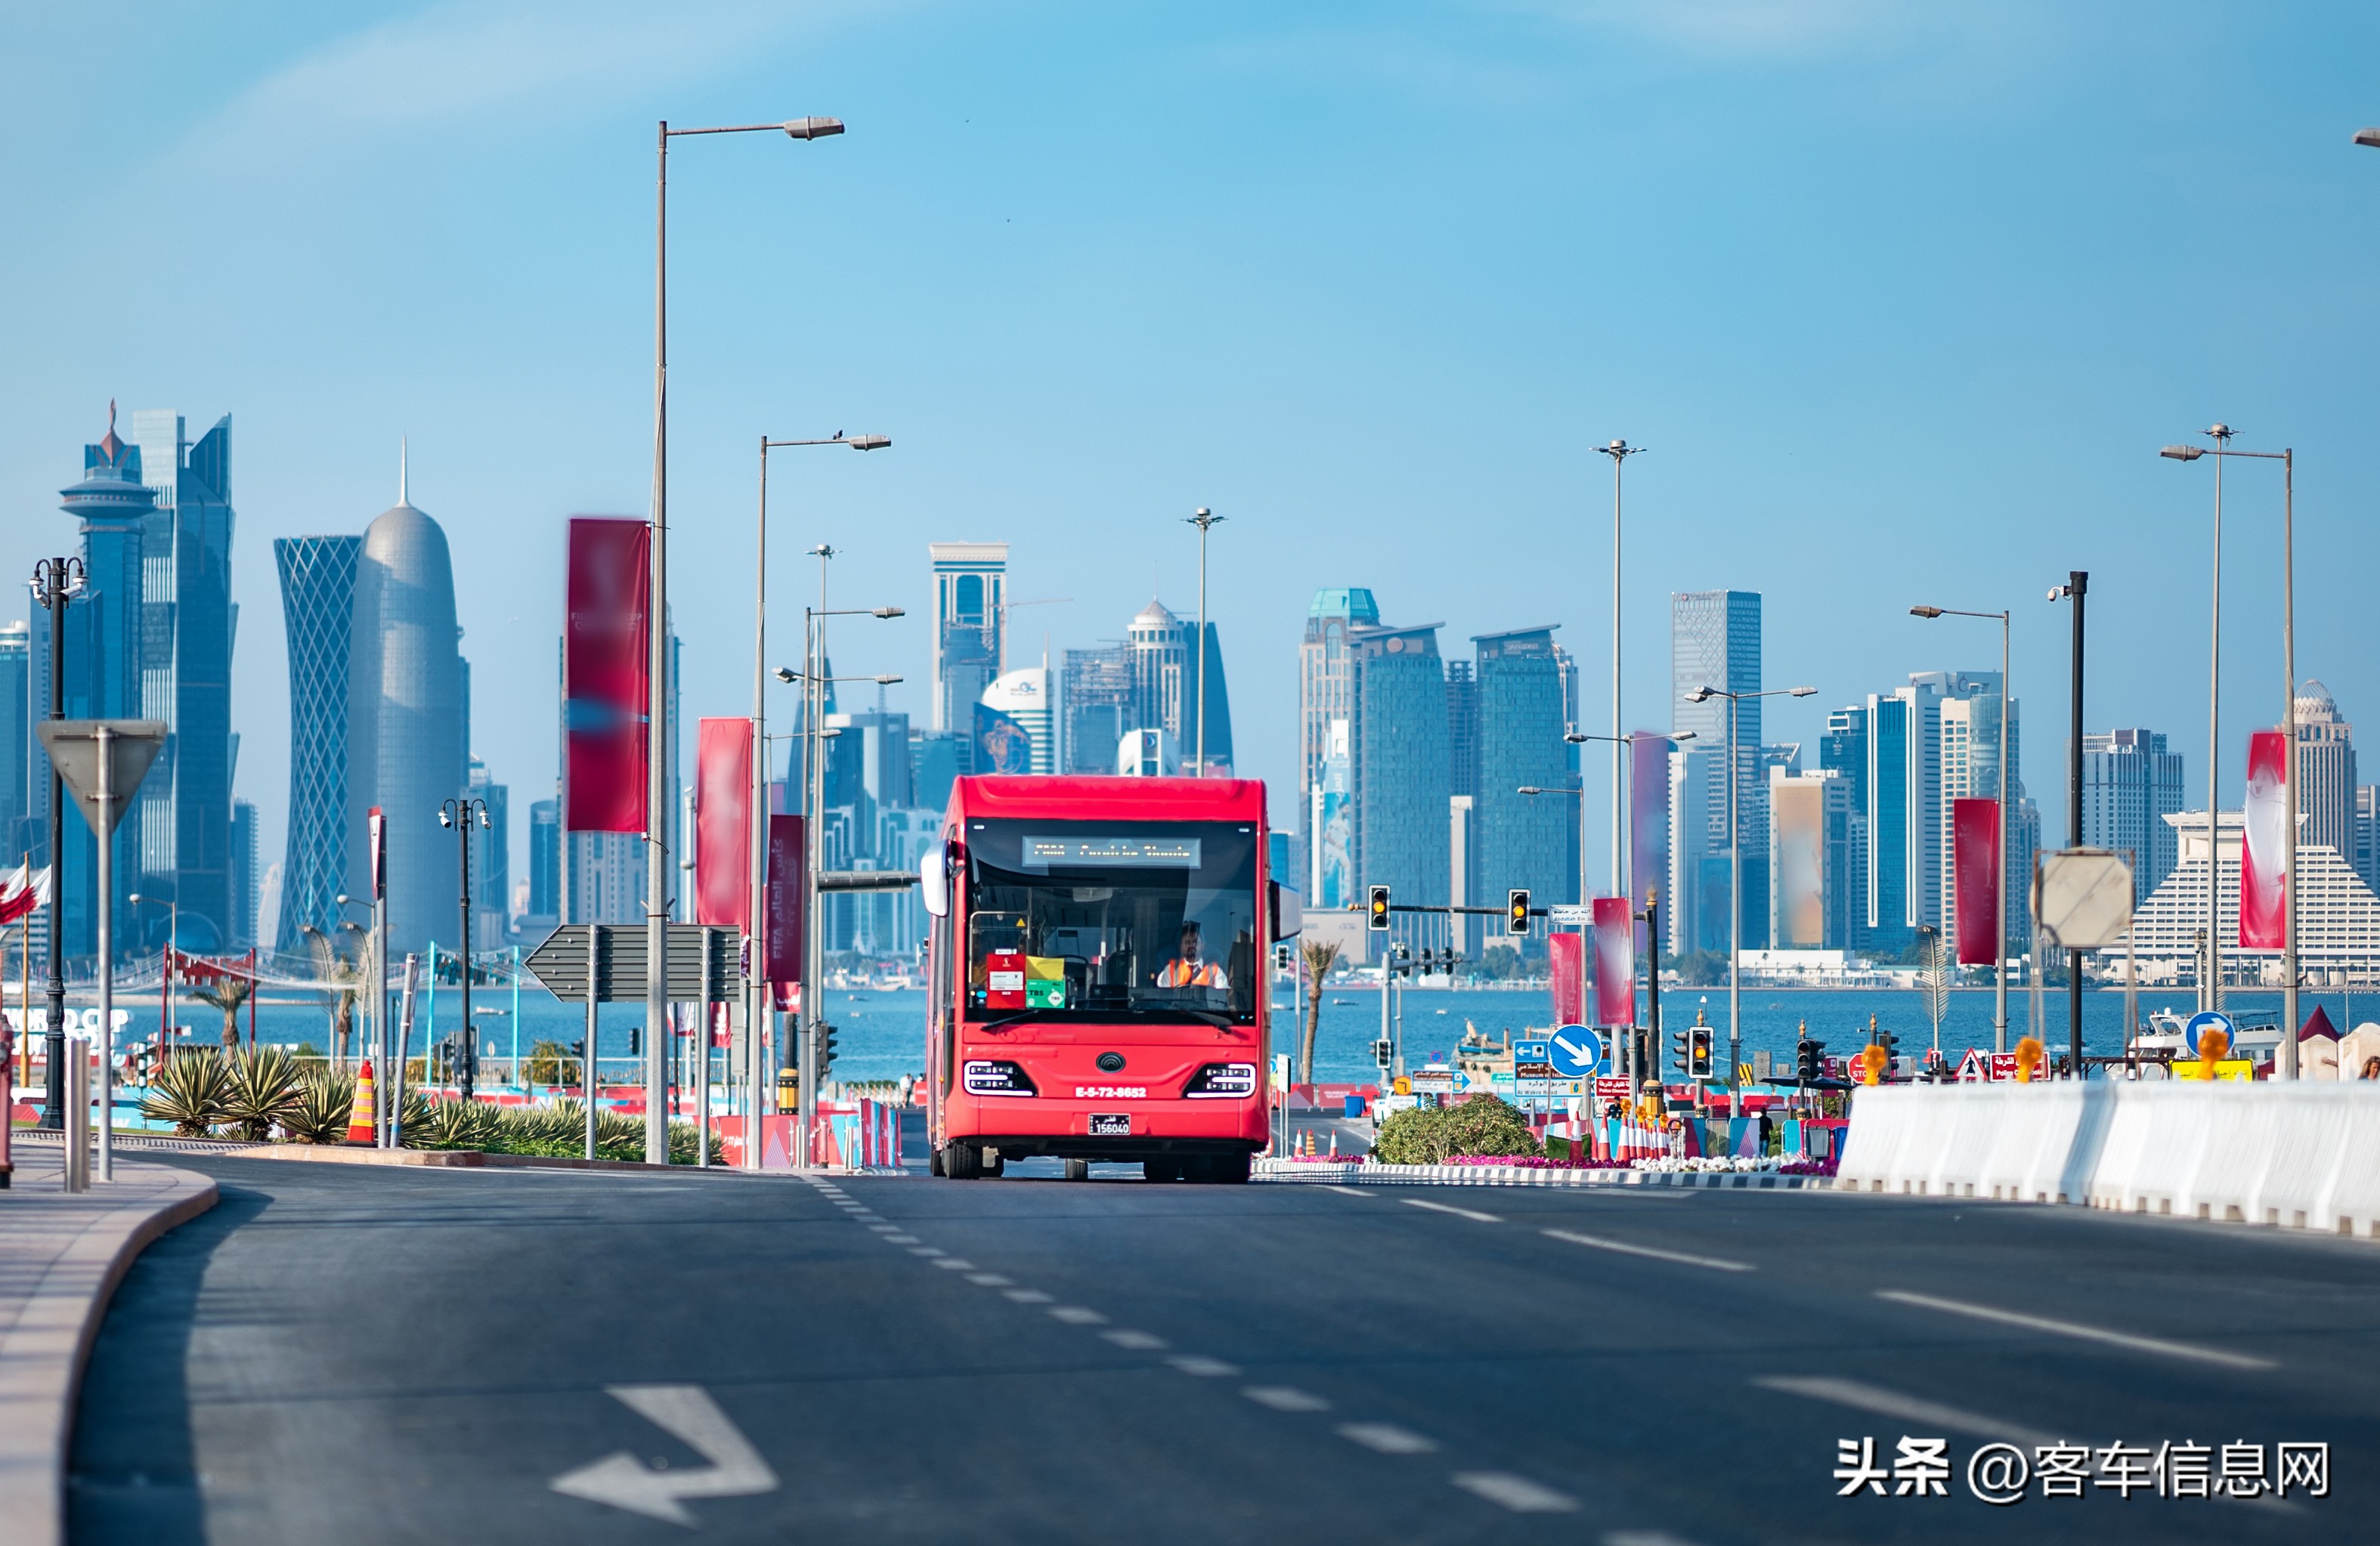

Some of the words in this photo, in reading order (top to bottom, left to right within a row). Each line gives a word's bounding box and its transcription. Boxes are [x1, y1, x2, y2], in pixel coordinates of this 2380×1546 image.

[771, 839, 785, 877] كأس
[772, 880, 786, 923] العالم
[773, 926, 784, 960] FIFA
[2, 1008, 79, 1031] WORD
[1075, 1087, 1147, 1098] E-5-72-8652
[1097, 1124, 1129, 1133] 156040
